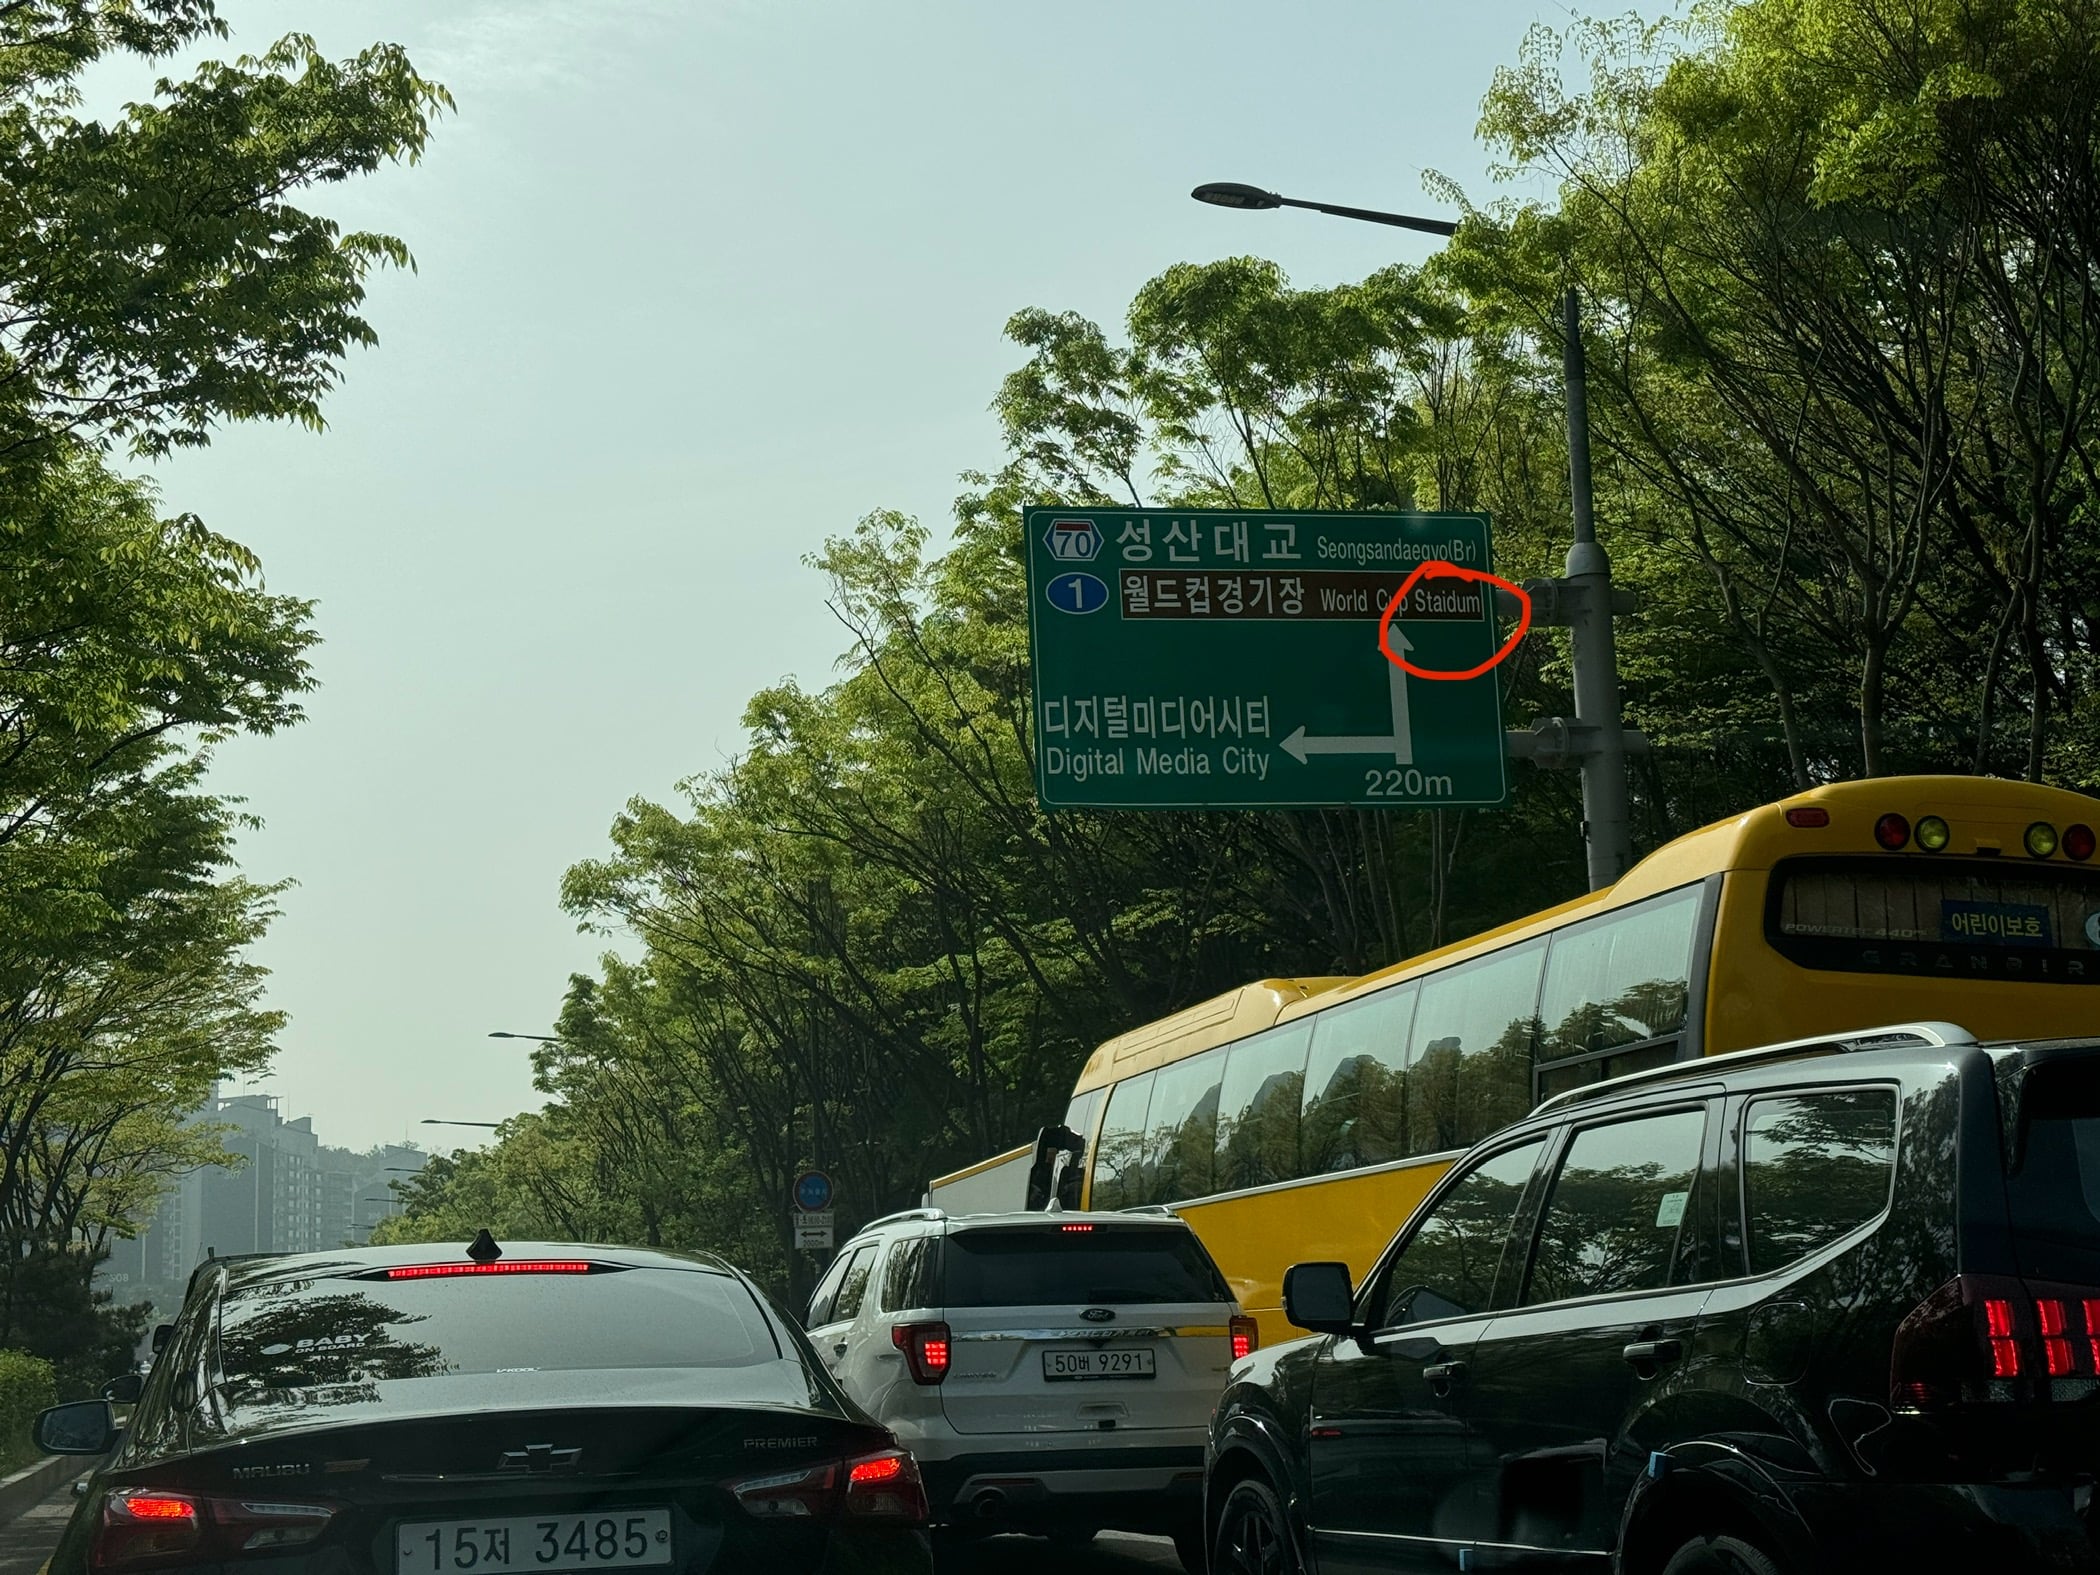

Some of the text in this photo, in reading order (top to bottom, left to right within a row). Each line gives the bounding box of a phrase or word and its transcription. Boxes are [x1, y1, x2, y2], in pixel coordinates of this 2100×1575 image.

[1056, 532, 1092, 557] 70
[1116, 519, 1302, 563] 성산대교
[1317, 535, 1476, 566] Seongsandaegyo(Br)
[1068, 578, 1083, 609] 1
[1124, 575, 1305, 614] 월드컵경기장
[1320, 588, 1368, 612] World
[1415, 588, 1481, 613] Staidum
[1045, 695, 1270, 738] 디지털미디어시티
[1047, 746, 1270, 782] Digital Media City
[1365, 769, 1453, 796] 220m
[1951, 912, 2043, 937] 어린이보호
[295, 1342, 366, 1354] ON BOARD
[296, 1333, 372, 1348] BABY
[1055, 1353, 1142, 1373] 50버 9291
[743, 1436, 817, 1449] PREMIER
[232, 1463, 311, 1480] MALIBU
[424, 1517, 648, 1571] 15저 3485
